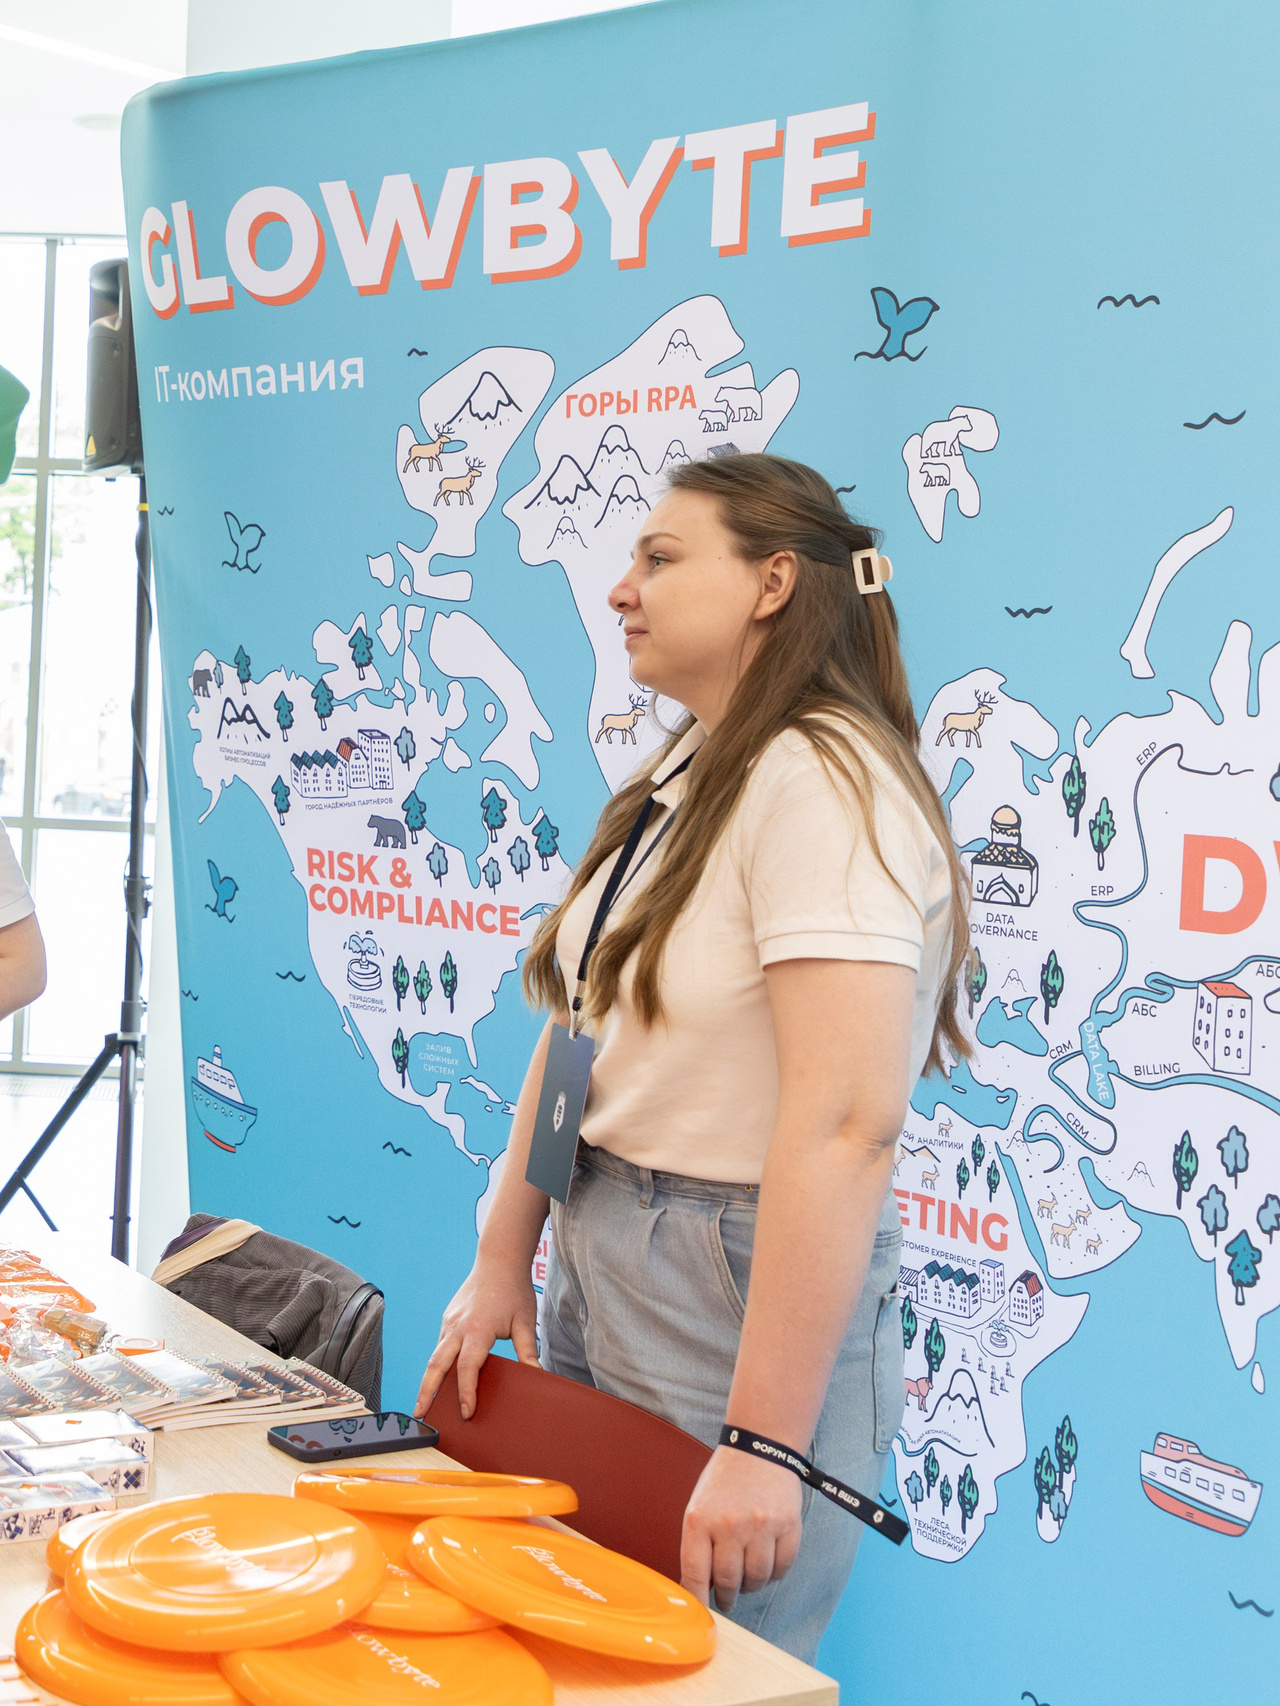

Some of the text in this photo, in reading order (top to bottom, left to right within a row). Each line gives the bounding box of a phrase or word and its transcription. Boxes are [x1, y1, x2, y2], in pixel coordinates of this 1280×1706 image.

[140, 102, 876, 319] GLOWBYTE
[154, 357, 365, 403] IT-компания
[566, 384, 697, 418] ГОРЫ RPA
[1136, 741, 1158, 766] ERP
[305, 797, 394, 811] ГОРОД НАДЁЖНЫХ ПАРТНЁРОВ
[307, 847, 413, 890] RISK &
[1091, 885, 1114, 896] ERP
[309, 883, 521, 937] COMPLIANCE
[986, 912, 1015, 925] DATA
[970, 923, 1038, 942] OVERNANCE
[349, 993, 384, 1006] ПЕРЕДОВЫЕ
[349, 1001, 388, 1014] ТЕХНОЛОГИИ
[1132, 1002, 1157, 1018] АБС
[425, 1043, 452, 1054] ЗАЛИВ
[1049, 1040, 1074, 1060] CRM
[418, 1052, 459, 1066] СЛОЖНЫХ
[1083, 1021, 1110, 1101] DATA LAKE
[423, 1064, 455, 1076] СИСТЕМ
[1134, 1063, 1181, 1076] BILLING
[1066, 1112, 1089, 1139] CRM
[917, 1136, 964, 1150] АНАЛИТИКИ
[931, 1250, 977, 1267] EXPERIENCE
[752, 1441, 787, 1461] ФОРУМ
[838, 1490, 860, 1508] ВШЭ
[914, 1518, 967, 1547] ТЕХНИЧЕСКОЙ
[930, 1517, 950, 1531] ЛЕСА
[917, 1528, 964, 1554] ПОДДЕРЖКИ
